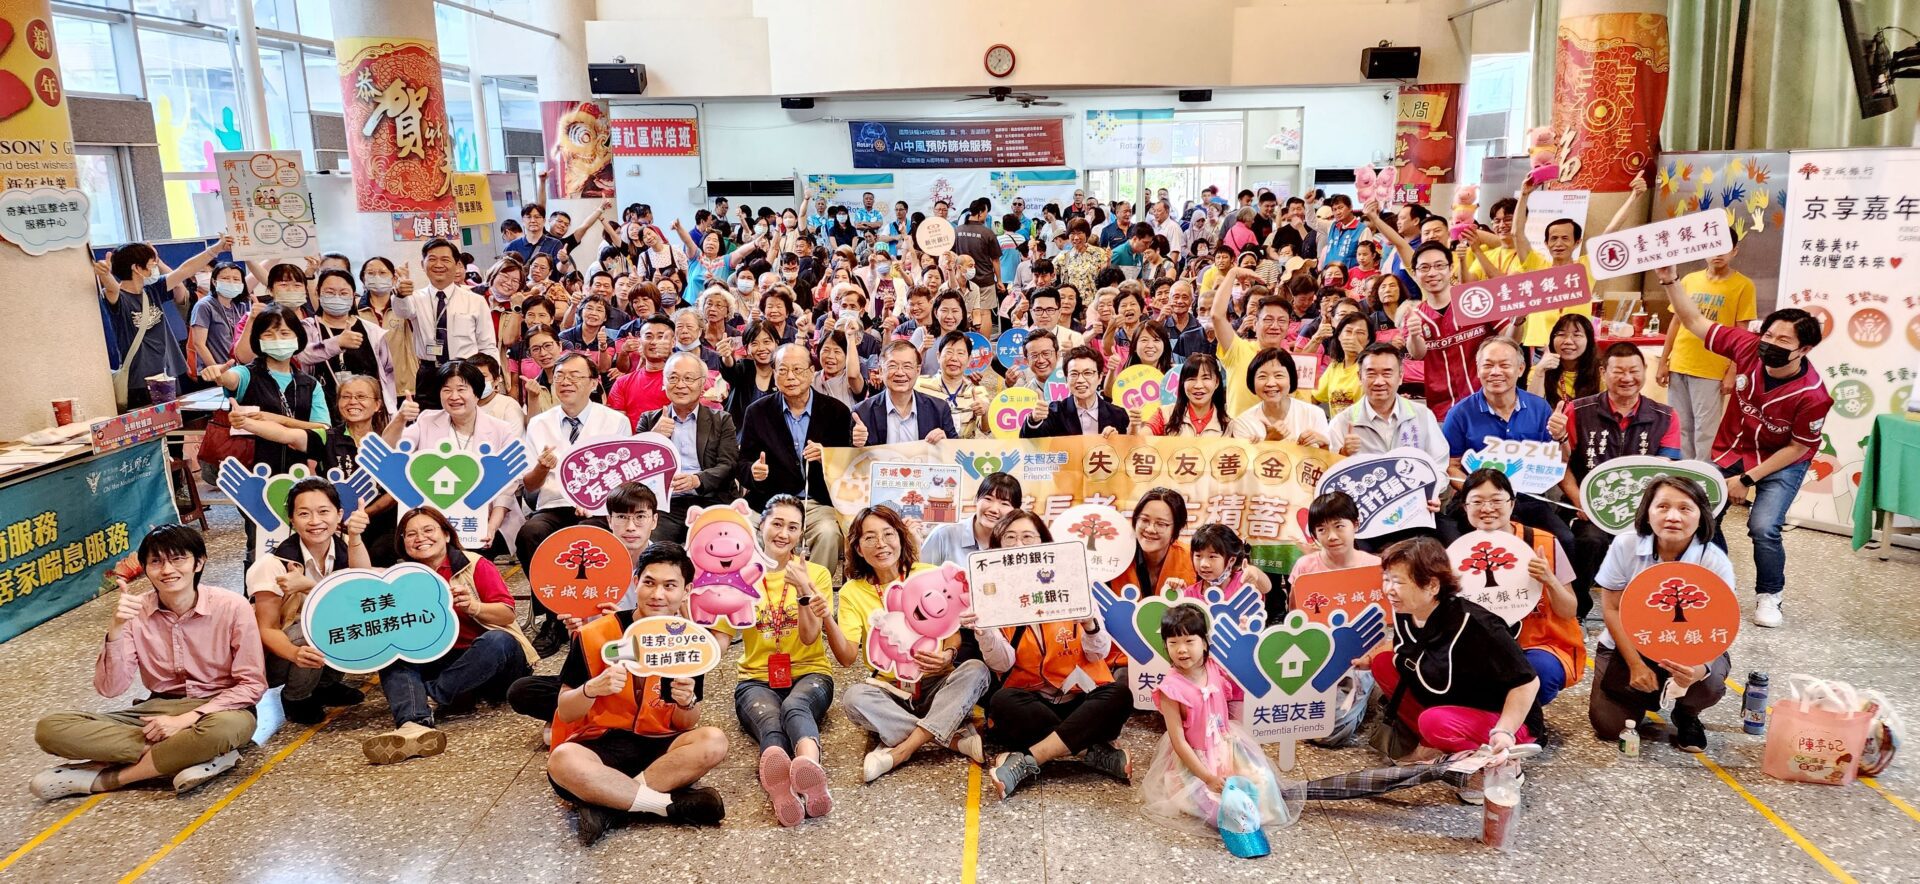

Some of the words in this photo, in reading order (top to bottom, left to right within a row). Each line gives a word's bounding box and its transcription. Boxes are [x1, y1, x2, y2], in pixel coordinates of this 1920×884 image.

[32, 25, 59, 102] 新年
[1398, 101, 1430, 119] 人間
[16, 161, 40, 170] best
[1393, 188, 1419, 204] 食區
[6, 201, 80, 217] 奇美社區整合型
[25, 217, 67, 230] 服務中心
[1634, 221, 1720, 253] 臺灣銀行
[1637, 253, 1663, 265] BANK
[1667, 249, 1680, 258] OF
[1684, 240, 1723, 254] TAIWAN
[1497, 273, 1581, 301] 臺灣銀行
[1500, 301, 1526, 312] BANK
[1529, 298, 1542, 307] OF
[1545, 291, 1583, 304] TAIWAN
[1425, 341, 1440, 349] ANK
[1441, 338, 1453, 347] OF
[1454, 326, 1486, 341] TAIWAN
[1024, 452, 1068, 465] 失智友善
[1486, 440, 1559, 460] 2024
[584, 449, 665, 503] 友善服務
[1088, 449, 1324, 488] 失智友善金融
[0, 522, 130, 607] 居家喘息服務
[976, 551, 1056, 572] 不一樣的銀行
[1091, 554, 1120, 568] 銀行
[540, 583, 621, 600] 京城銀行
[1019, 589, 1070, 608] 京城銀行
[1333, 588, 1384, 606] 京城銀
[360, 592, 396, 614] 奇美
[328, 609, 436, 646] 居家服務中心
[1634, 627, 1729, 646] 京城銀行
[646, 651, 701, 666] 哇尚實在
[1252, 700, 1327, 726] 失智友善
[1252, 726, 1292, 738] Dementia
[1293, 722, 1325, 734] Friends
